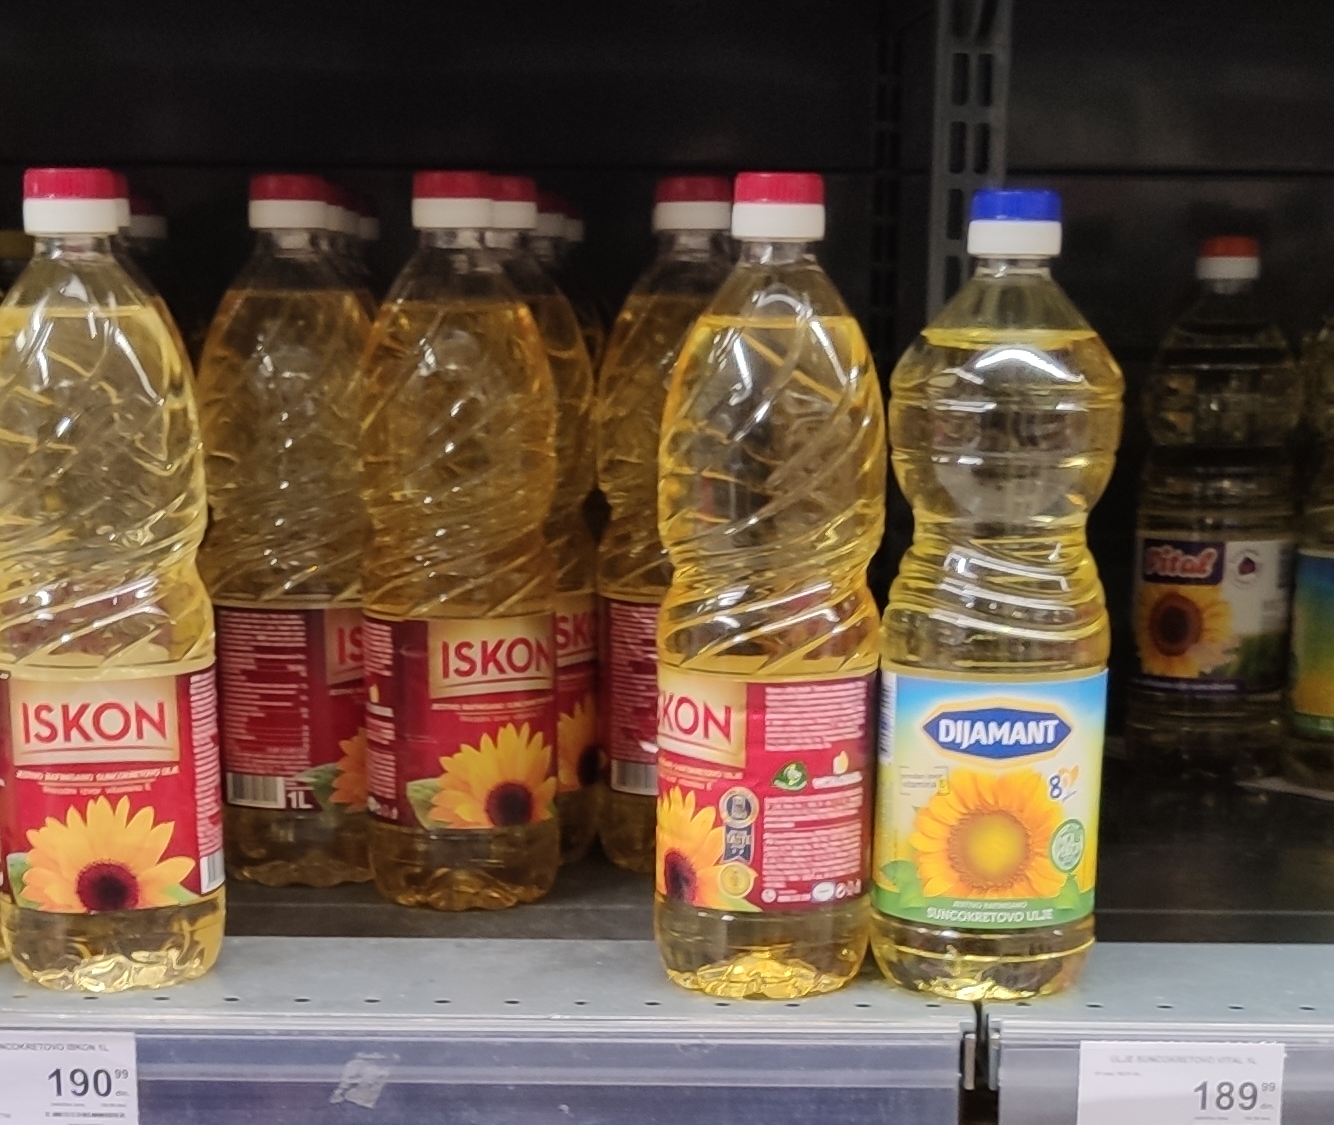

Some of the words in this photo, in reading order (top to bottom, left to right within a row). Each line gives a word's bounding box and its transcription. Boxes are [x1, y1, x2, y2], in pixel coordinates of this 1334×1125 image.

[441, 636, 551, 680] ISKON
[22, 702, 166, 744] ISKON
[659, 692, 733, 745] KON
[938, 718, 1060, 749] DIJAMANT
[1026, 908, 1054, 921] ULJE
[47, 1067, 113, 1097] 190
[1193, 1080, 1258, 1111] 189
